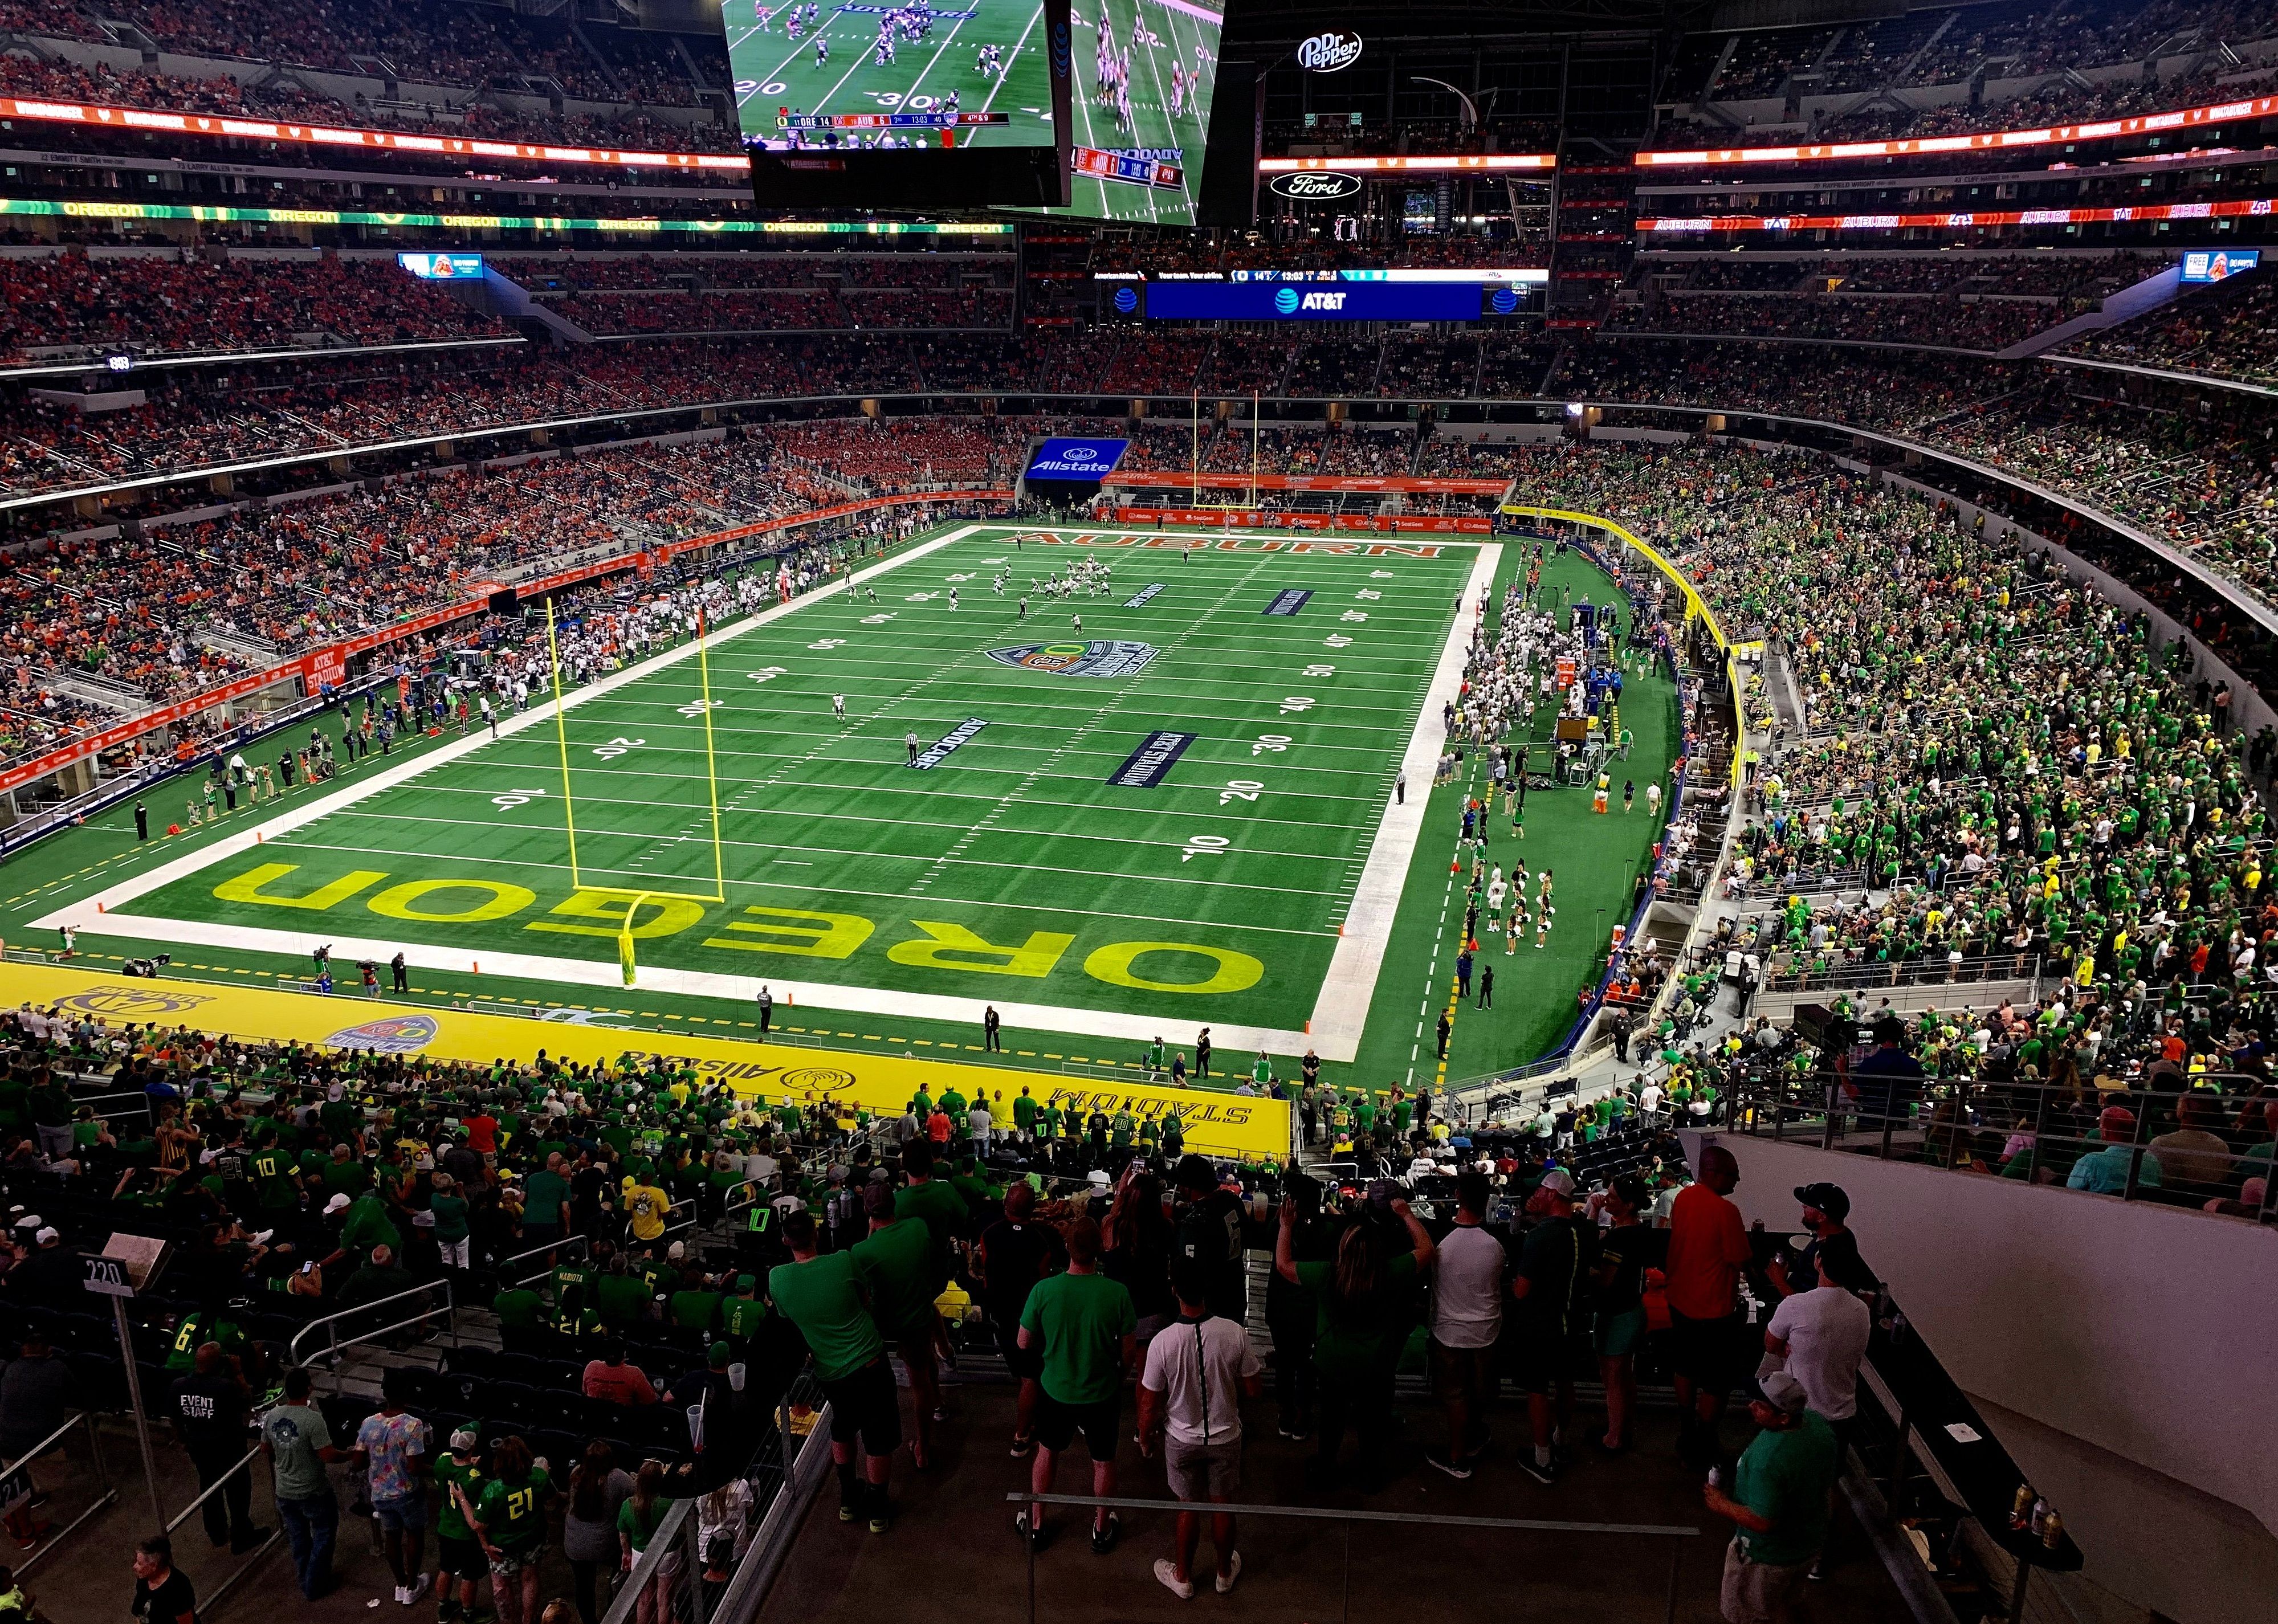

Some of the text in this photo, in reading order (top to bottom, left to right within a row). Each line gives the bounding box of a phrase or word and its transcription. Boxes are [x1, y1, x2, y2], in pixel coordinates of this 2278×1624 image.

[1322, 33, 1344, 51] Dr
[1305, 37, 1358, 68] Pepper
[736, 80, 786, 95] 20
[877, 92, 934, 109] 30
[2210, 103, 2252, 119] WHATABURGER
[800, 117, 816, 126] ORE
[821, 117, 830, 126] 14
[857, 117, 874, 125] AUB
[912, 116, 928, 124] 13:03
[1289, 174, 1342, 194] Ford
[63, 202, 144, 217] OREGON
[270, 210, 339, 223] OREGON
[2020, 210, 2071, 224] AUBURN
[2170, 203, 2212, 218] AUBURN
[442, 215, 500, 227] OREGON
[600, 220, 659, 230] OREGON
[764, 222, 828, 232] OREGON
[939, 223, 1003, 233] OREGON
[1654, 219, 1712, 230] AUBURN
[1841, 215, 1899, 228] AUBURN
[2189, 256, 2207, 266] FREE
[1254, 271, 1264, 280] 14
[1281, 272, 1304, 280] 13:03
[1302, 292, 1346, 309] AT&T
[1031, 461, 1110, 472] Allstate
[992, 533, 1446, 558] AUBURN
[1370, 569, 1395, 578] 10
[1123, 583, 1167, 608] ADVOCARE
[1355, 590, 1382, 600] 20
[859, 613, 894, 624] 40
[1340, 611, 1369, 622] 30
[808, 638, 847, 650] 50
[1323, 636, 1354, 648] 40
[313, 652, 335, 671] AT&T
[307, 663, 346, 691] STADIUM
[747, 666, 788, 680] 40
[1302, 664, 1336, 677] 50
[677, 699, 724, 715] 30
[1285, 696, 1316, 711] 40
[592, 737, 646, 756] 20
[1255, 735, 1293, 752] 30
[1120, 732, 1185, 787] AT&T STADIUM
[491, 789, 546, 806] 10
[1222, 781, 1265, 801] 20
[1185, 835, 1230, 855] 10
[213, 863, 1265, 994] OREGON
[81, 986, 218, 1002] ADVOCARE
[1049, 1088, 1253, 1124] STADIUM
[960, 1116, 968, 1128] 8
[1114, 1119, 1128, 1131] 20
[1035, 1124, 1048, 1137] 10
[255, 1157, 276, 1177] 10
[748, 1208, 771, 1232] 10
[85, 1260, 122, 1286] 220
[558, 1271, 582, 1283] MARIOTA
[181, 1395, 214, 1409] EVENT
[182, 1406, 215, 1419] STAFF
[508, 1487, 533, 1520] 21
